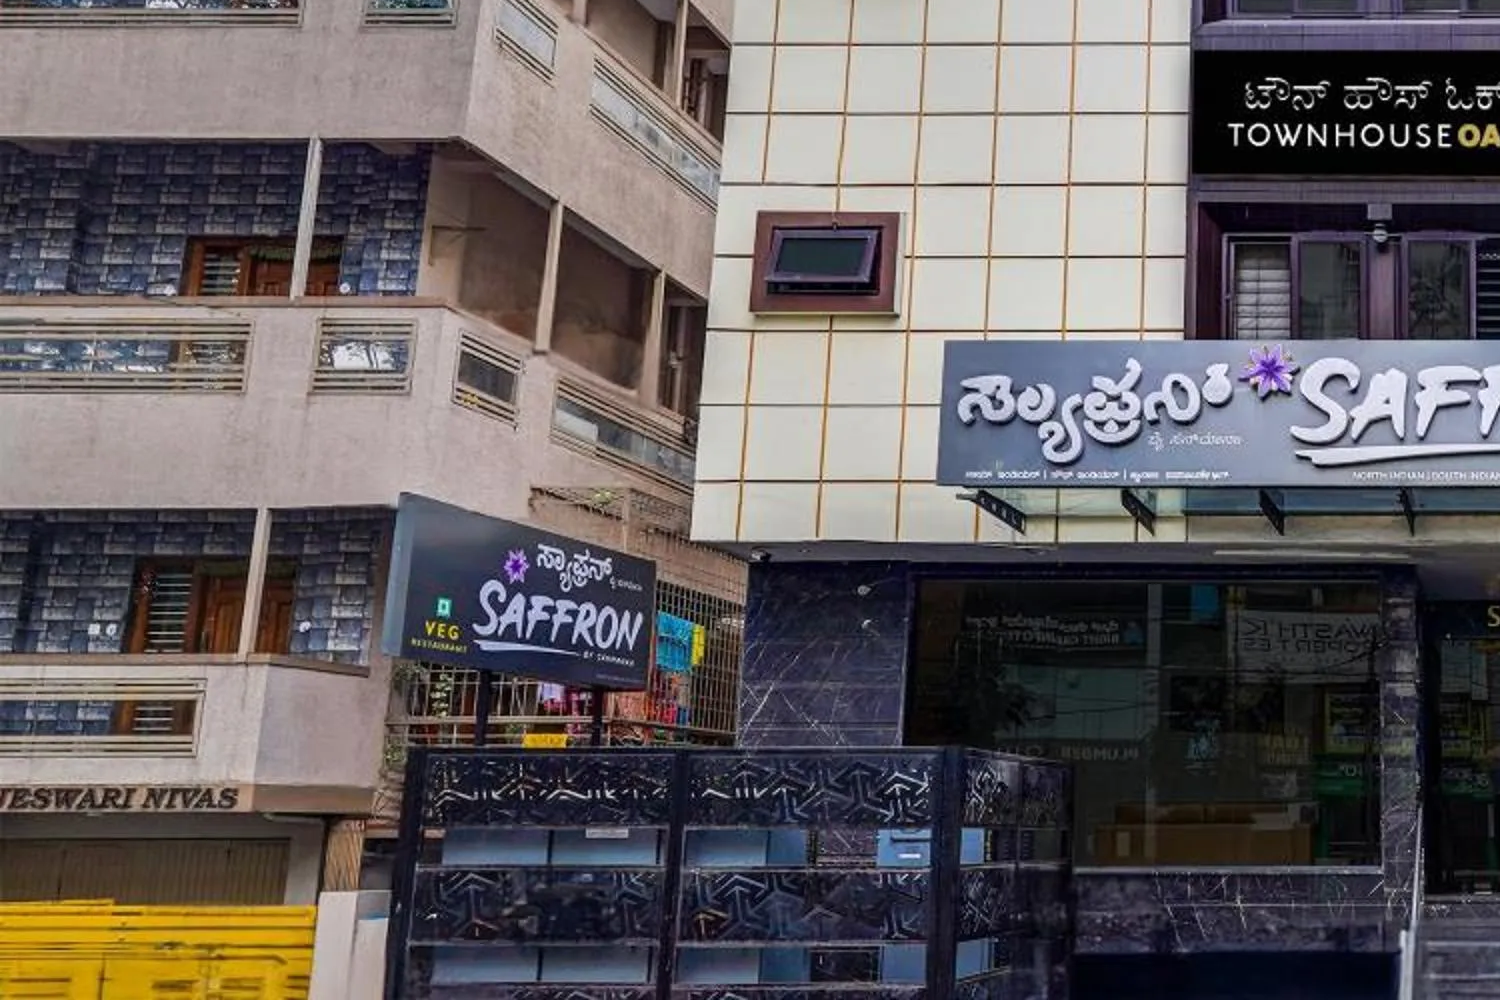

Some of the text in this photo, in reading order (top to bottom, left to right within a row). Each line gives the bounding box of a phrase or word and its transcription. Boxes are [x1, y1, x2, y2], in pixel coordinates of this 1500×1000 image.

[1227, 123, 1452, 148] TOWNHOUSE
[472, 580, 644, 651] SAFFRON
[425, 620, 461, 640] VEG
[142, 786, 239, 810] NIVAS
